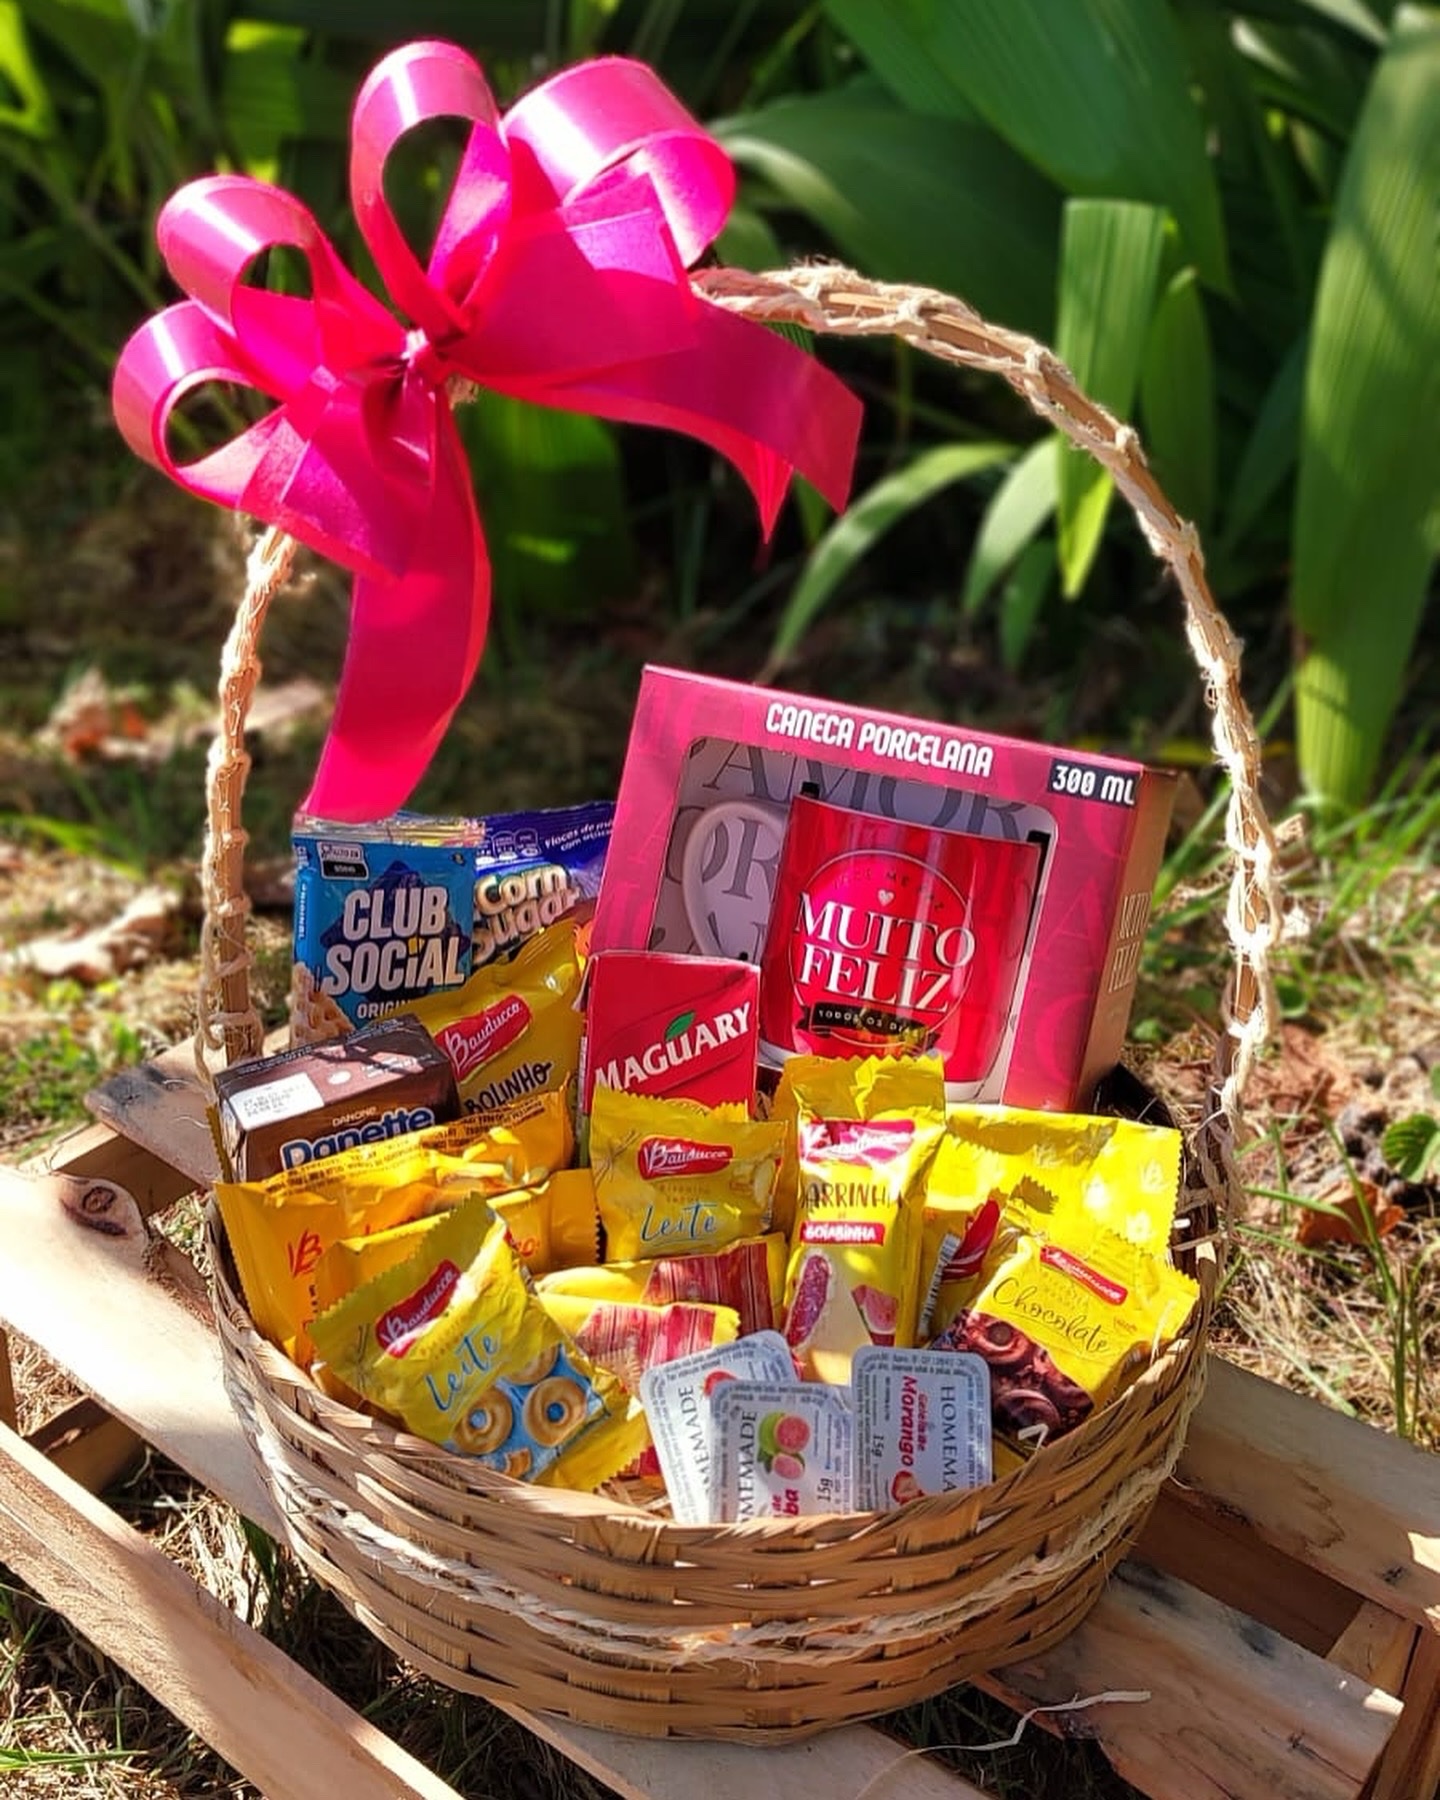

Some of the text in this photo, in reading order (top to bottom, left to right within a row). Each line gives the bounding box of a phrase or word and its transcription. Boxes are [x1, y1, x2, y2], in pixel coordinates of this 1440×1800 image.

[766, 704, 993, 778] CANECA PORCELANA
[1052, 765, 1136, 805] 300 ML
[343, 886, 449, 942] CLUB
[475, 864, 571, 916] Corn
[795, 891, 976, 970] MUITO
[799, 942, 952, 1013] FELIZ
[444, 1000, 521, 1071] Bauducco
[595, 1001, 750, 1091] MAGUARY
[332, 1105, 377, 1127] DANONE
[464, 1062, 552, 1114] BOLINHO
[281, 1106, 435, 1170] Danette
[644, 1140, 729, 1176] Bauducco
[640, 1200, 718, 1242] Leite
[804, 1224, 877, 1243] GOIABINHA
[993, 1276, 1108, 1352] Chocolate
[424, 1324, 501, 1413] Leite
[871, 1434, 884, 1458] 15g
[898, 1374, 918, 1468] Morango
[817, 1477, 833, 1503] 15g
